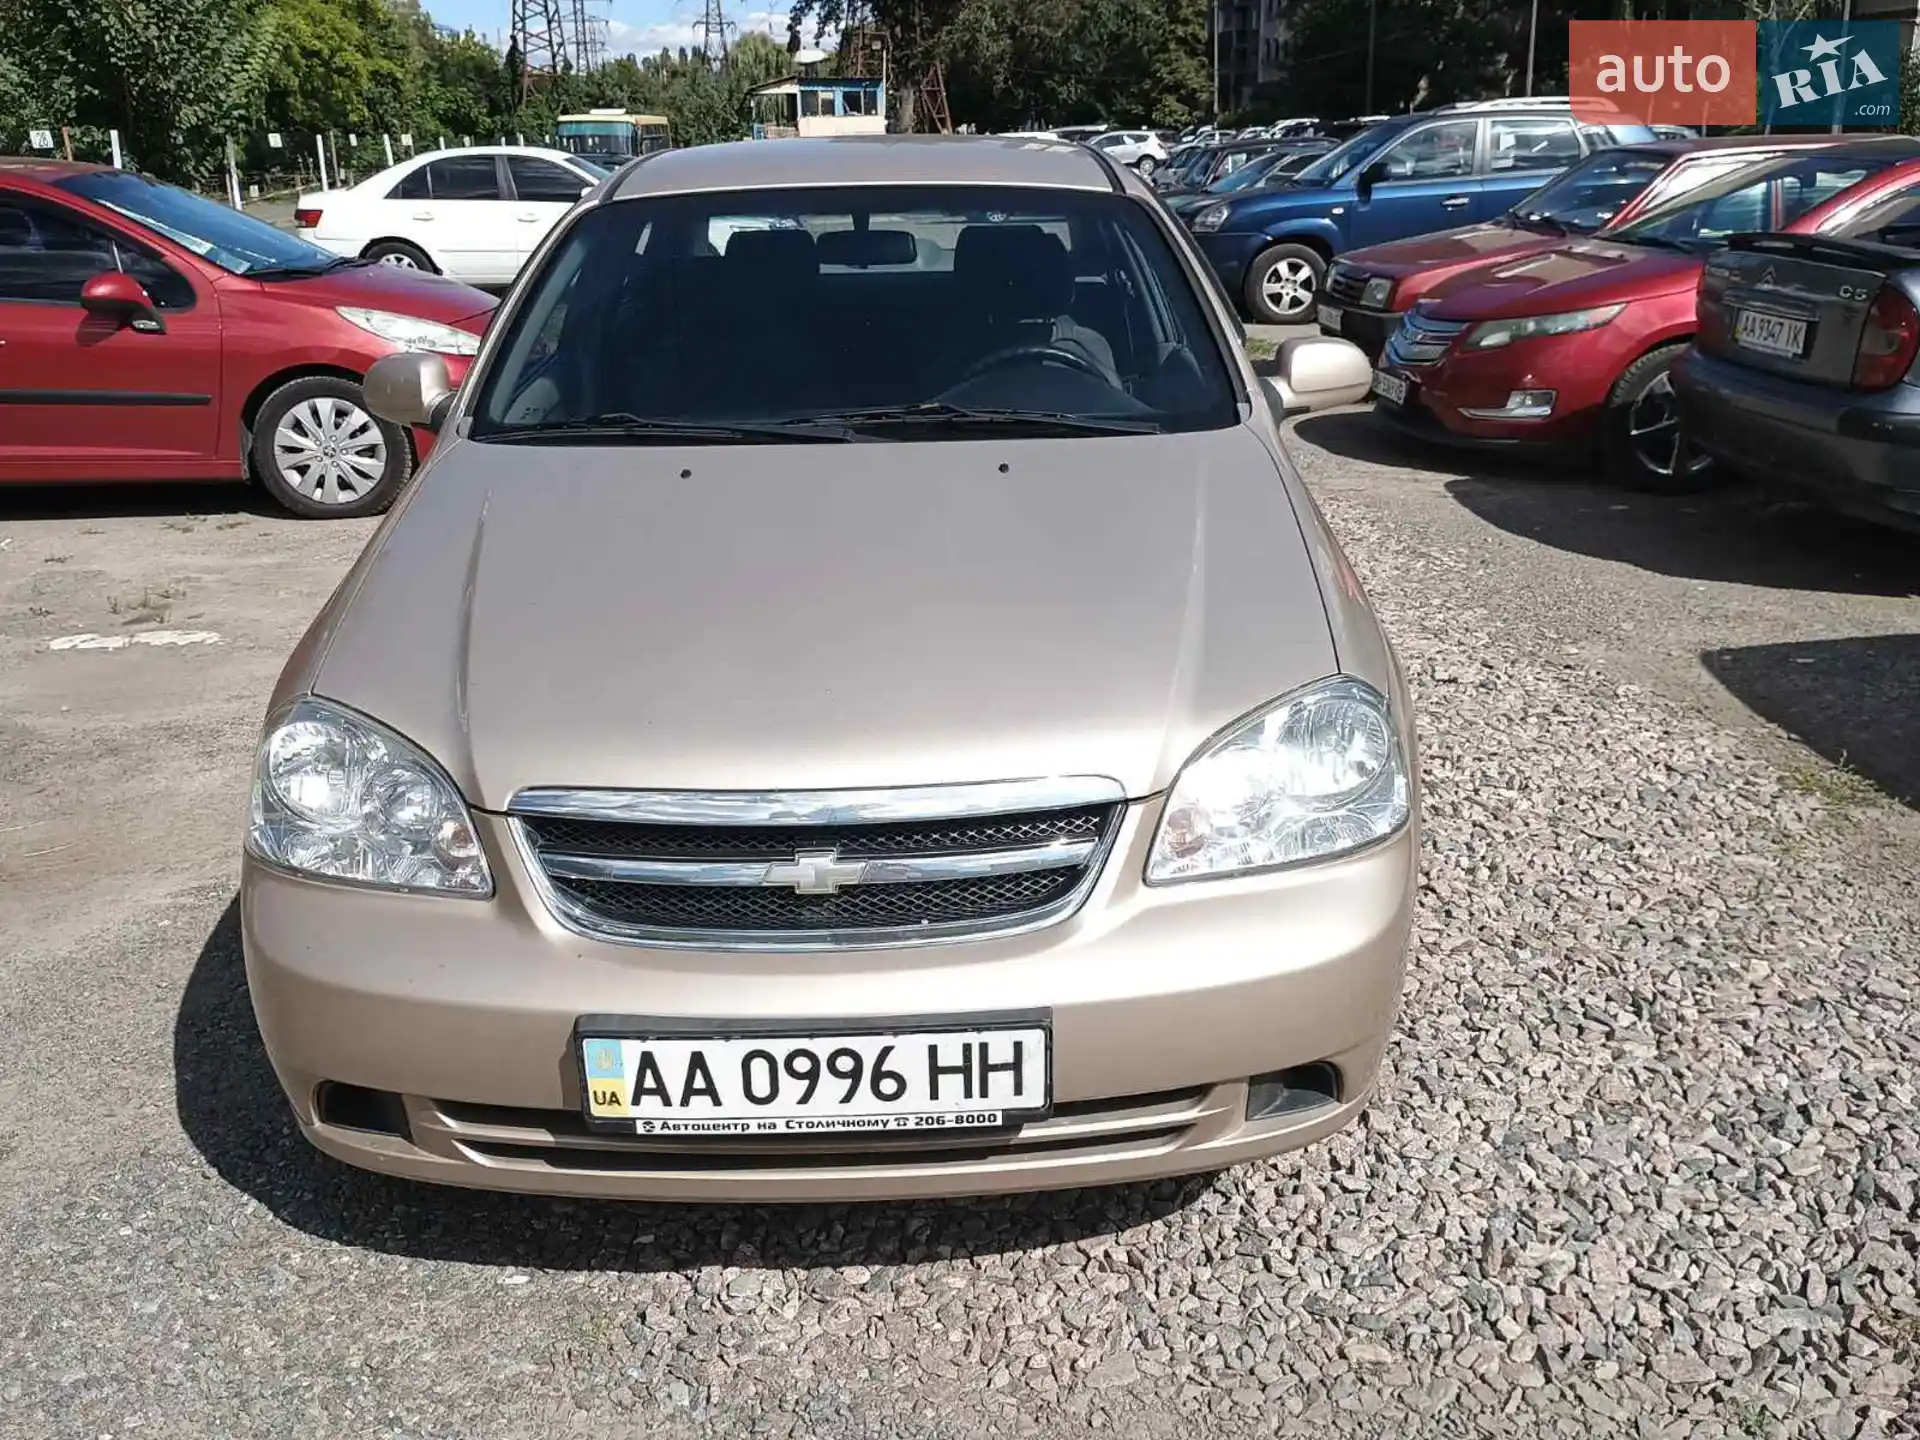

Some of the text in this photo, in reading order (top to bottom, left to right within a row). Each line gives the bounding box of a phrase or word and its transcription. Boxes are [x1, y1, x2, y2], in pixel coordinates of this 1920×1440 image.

[1839, 285, 1868, 301] C5
[631, 1041, 1024, 1107] AA 0996 HH
[593, 1090, 622, 1106] UA
[659, 1113, 998, 1132] Автоцентр на Столичному 206-8000
